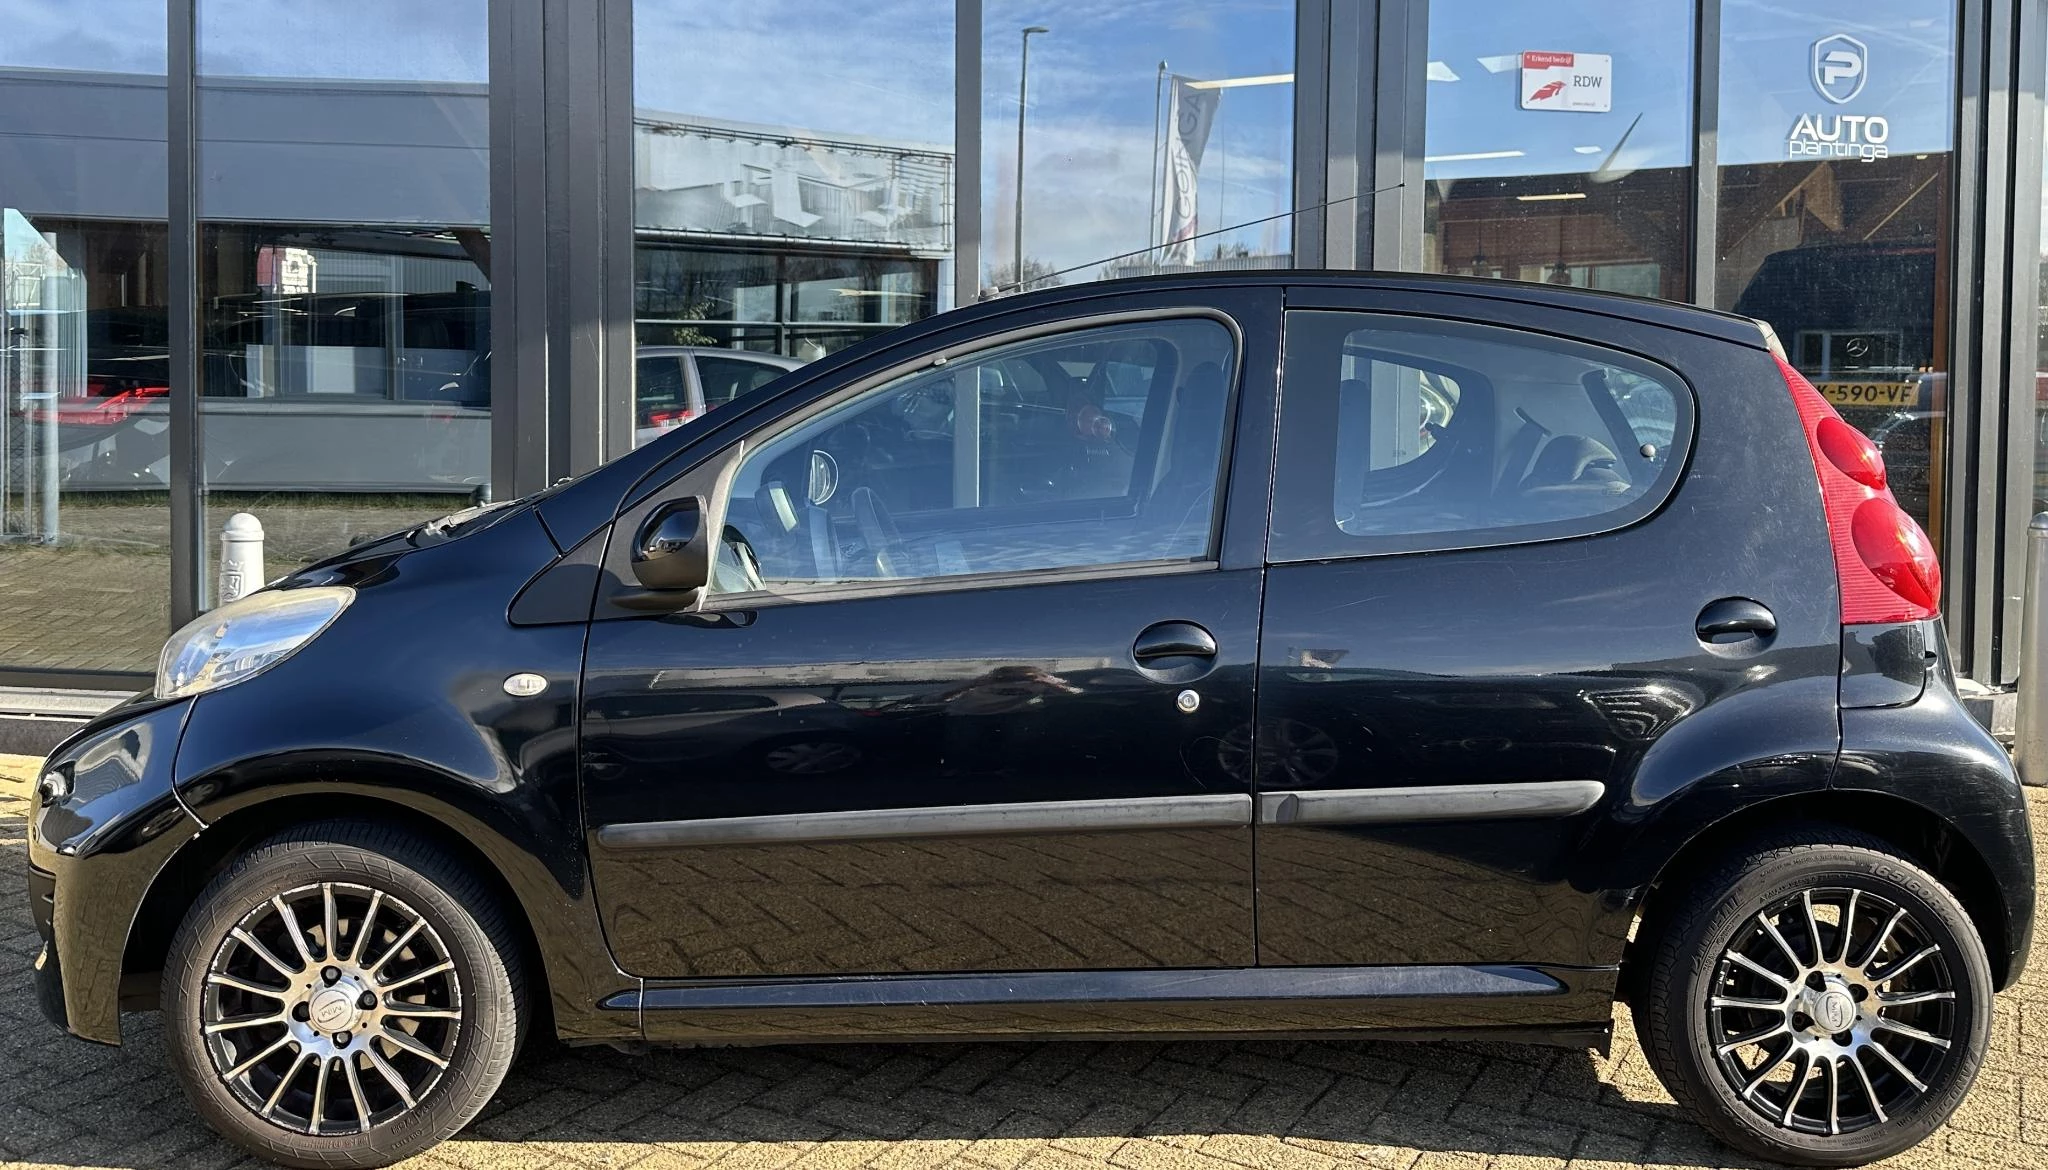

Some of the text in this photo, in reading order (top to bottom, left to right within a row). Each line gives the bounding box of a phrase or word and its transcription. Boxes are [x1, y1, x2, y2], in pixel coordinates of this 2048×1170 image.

[1532, 55, 1552, 63] Erkend
[1573, 75, 1602, 88] RDW
[1790, 113, 1889, 144] AUTO
[1789, 138, 1888, 163] plantinga
